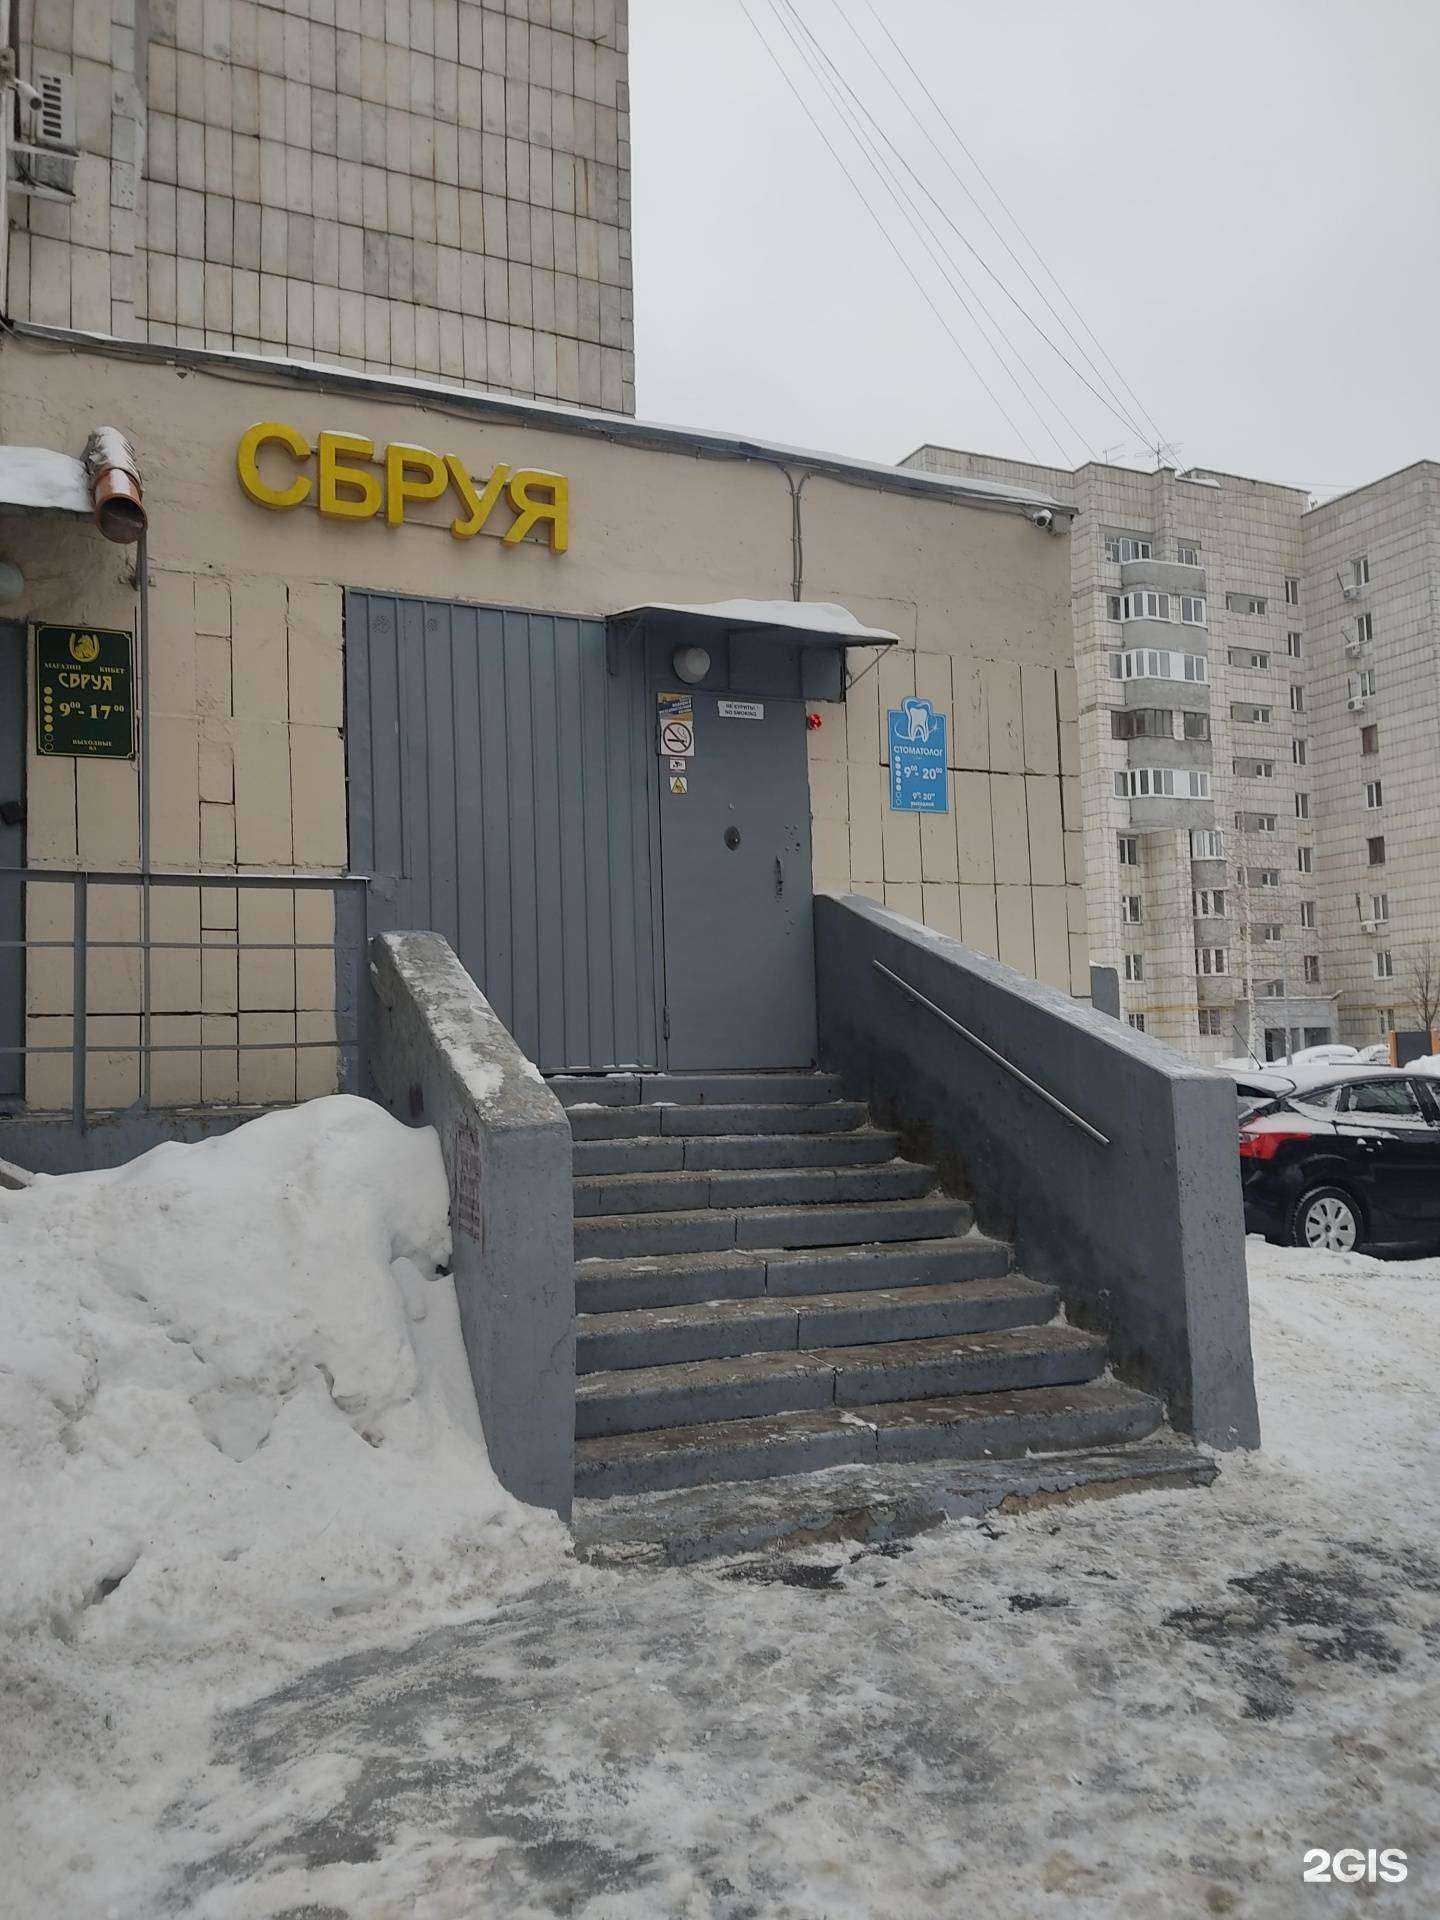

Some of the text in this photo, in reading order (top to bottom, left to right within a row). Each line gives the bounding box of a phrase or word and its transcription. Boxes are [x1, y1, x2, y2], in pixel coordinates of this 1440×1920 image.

[237, 421, 569, 555] СБРУЯ
[58, 673, 112, 691] СБРУЯ
[893, 745, 943, 756] СТОМАТОЛОГ
